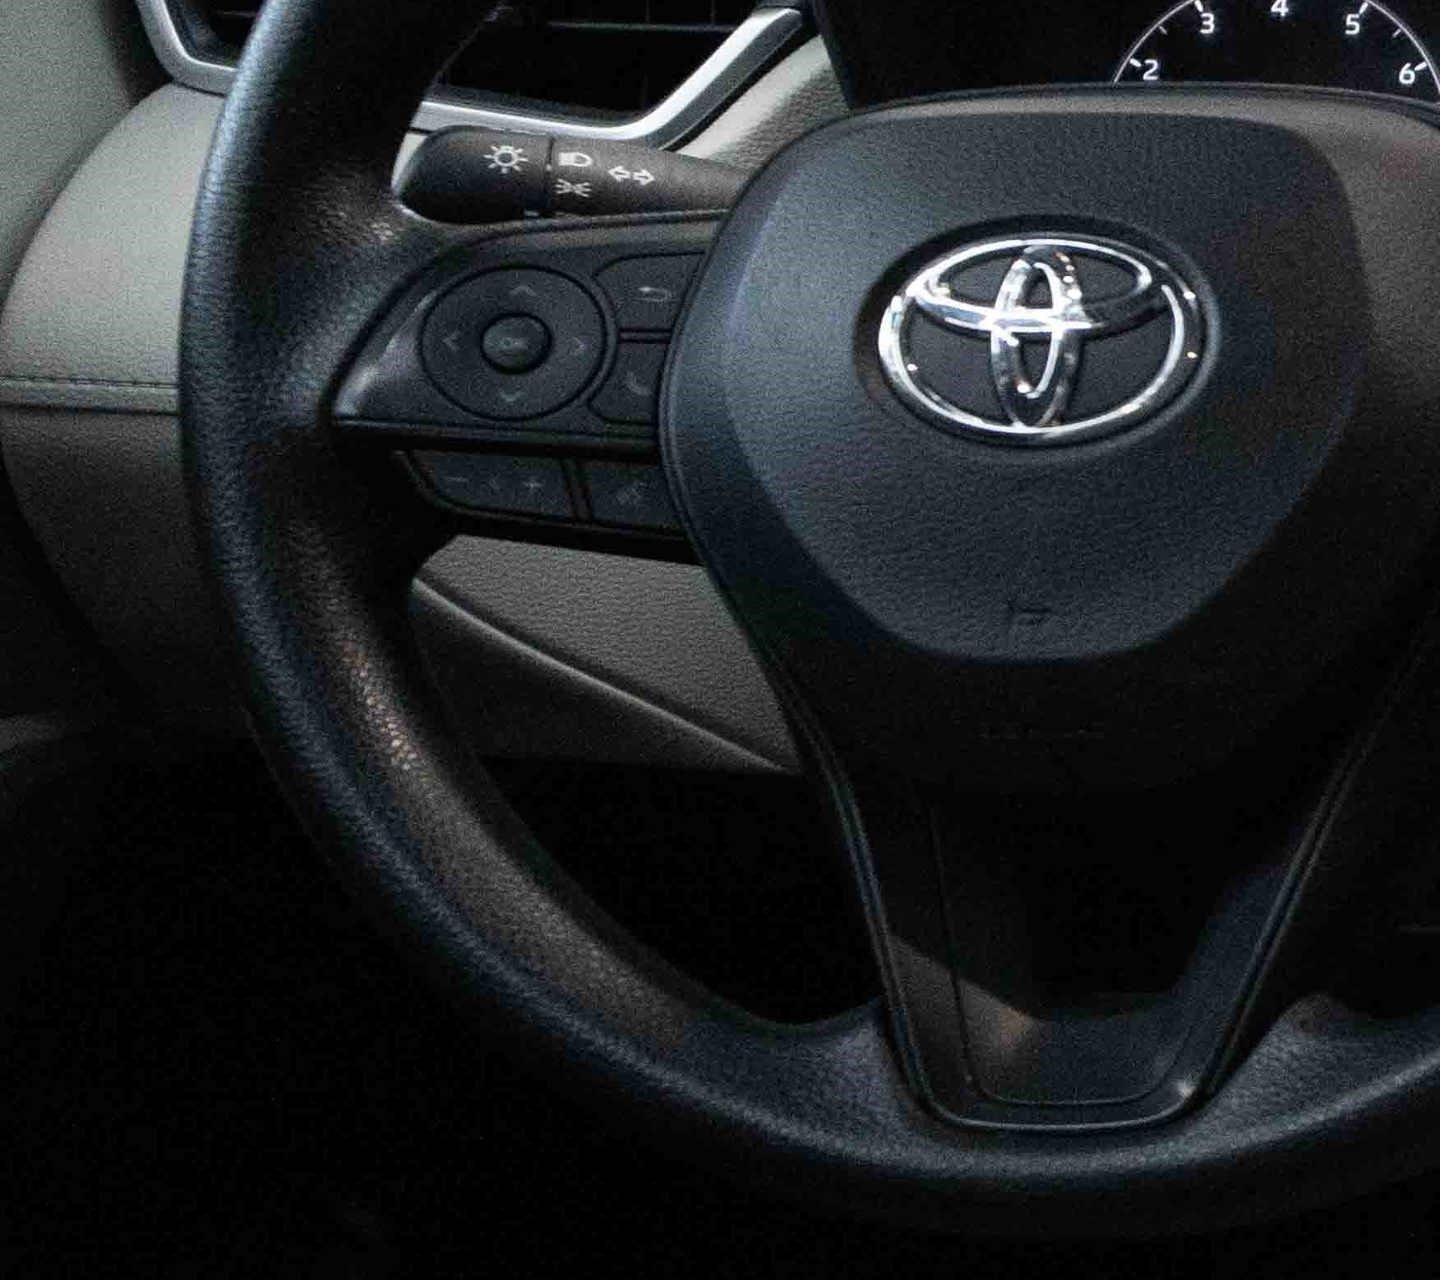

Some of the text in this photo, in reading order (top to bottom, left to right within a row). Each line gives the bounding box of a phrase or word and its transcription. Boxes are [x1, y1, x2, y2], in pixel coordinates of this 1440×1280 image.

[1200, 13, 1215, 35] 3
[1345, 14, 1360, 35] 5
[1142, 58, 1159, 81] 2
[1399, 63, 1416, 84] 6
